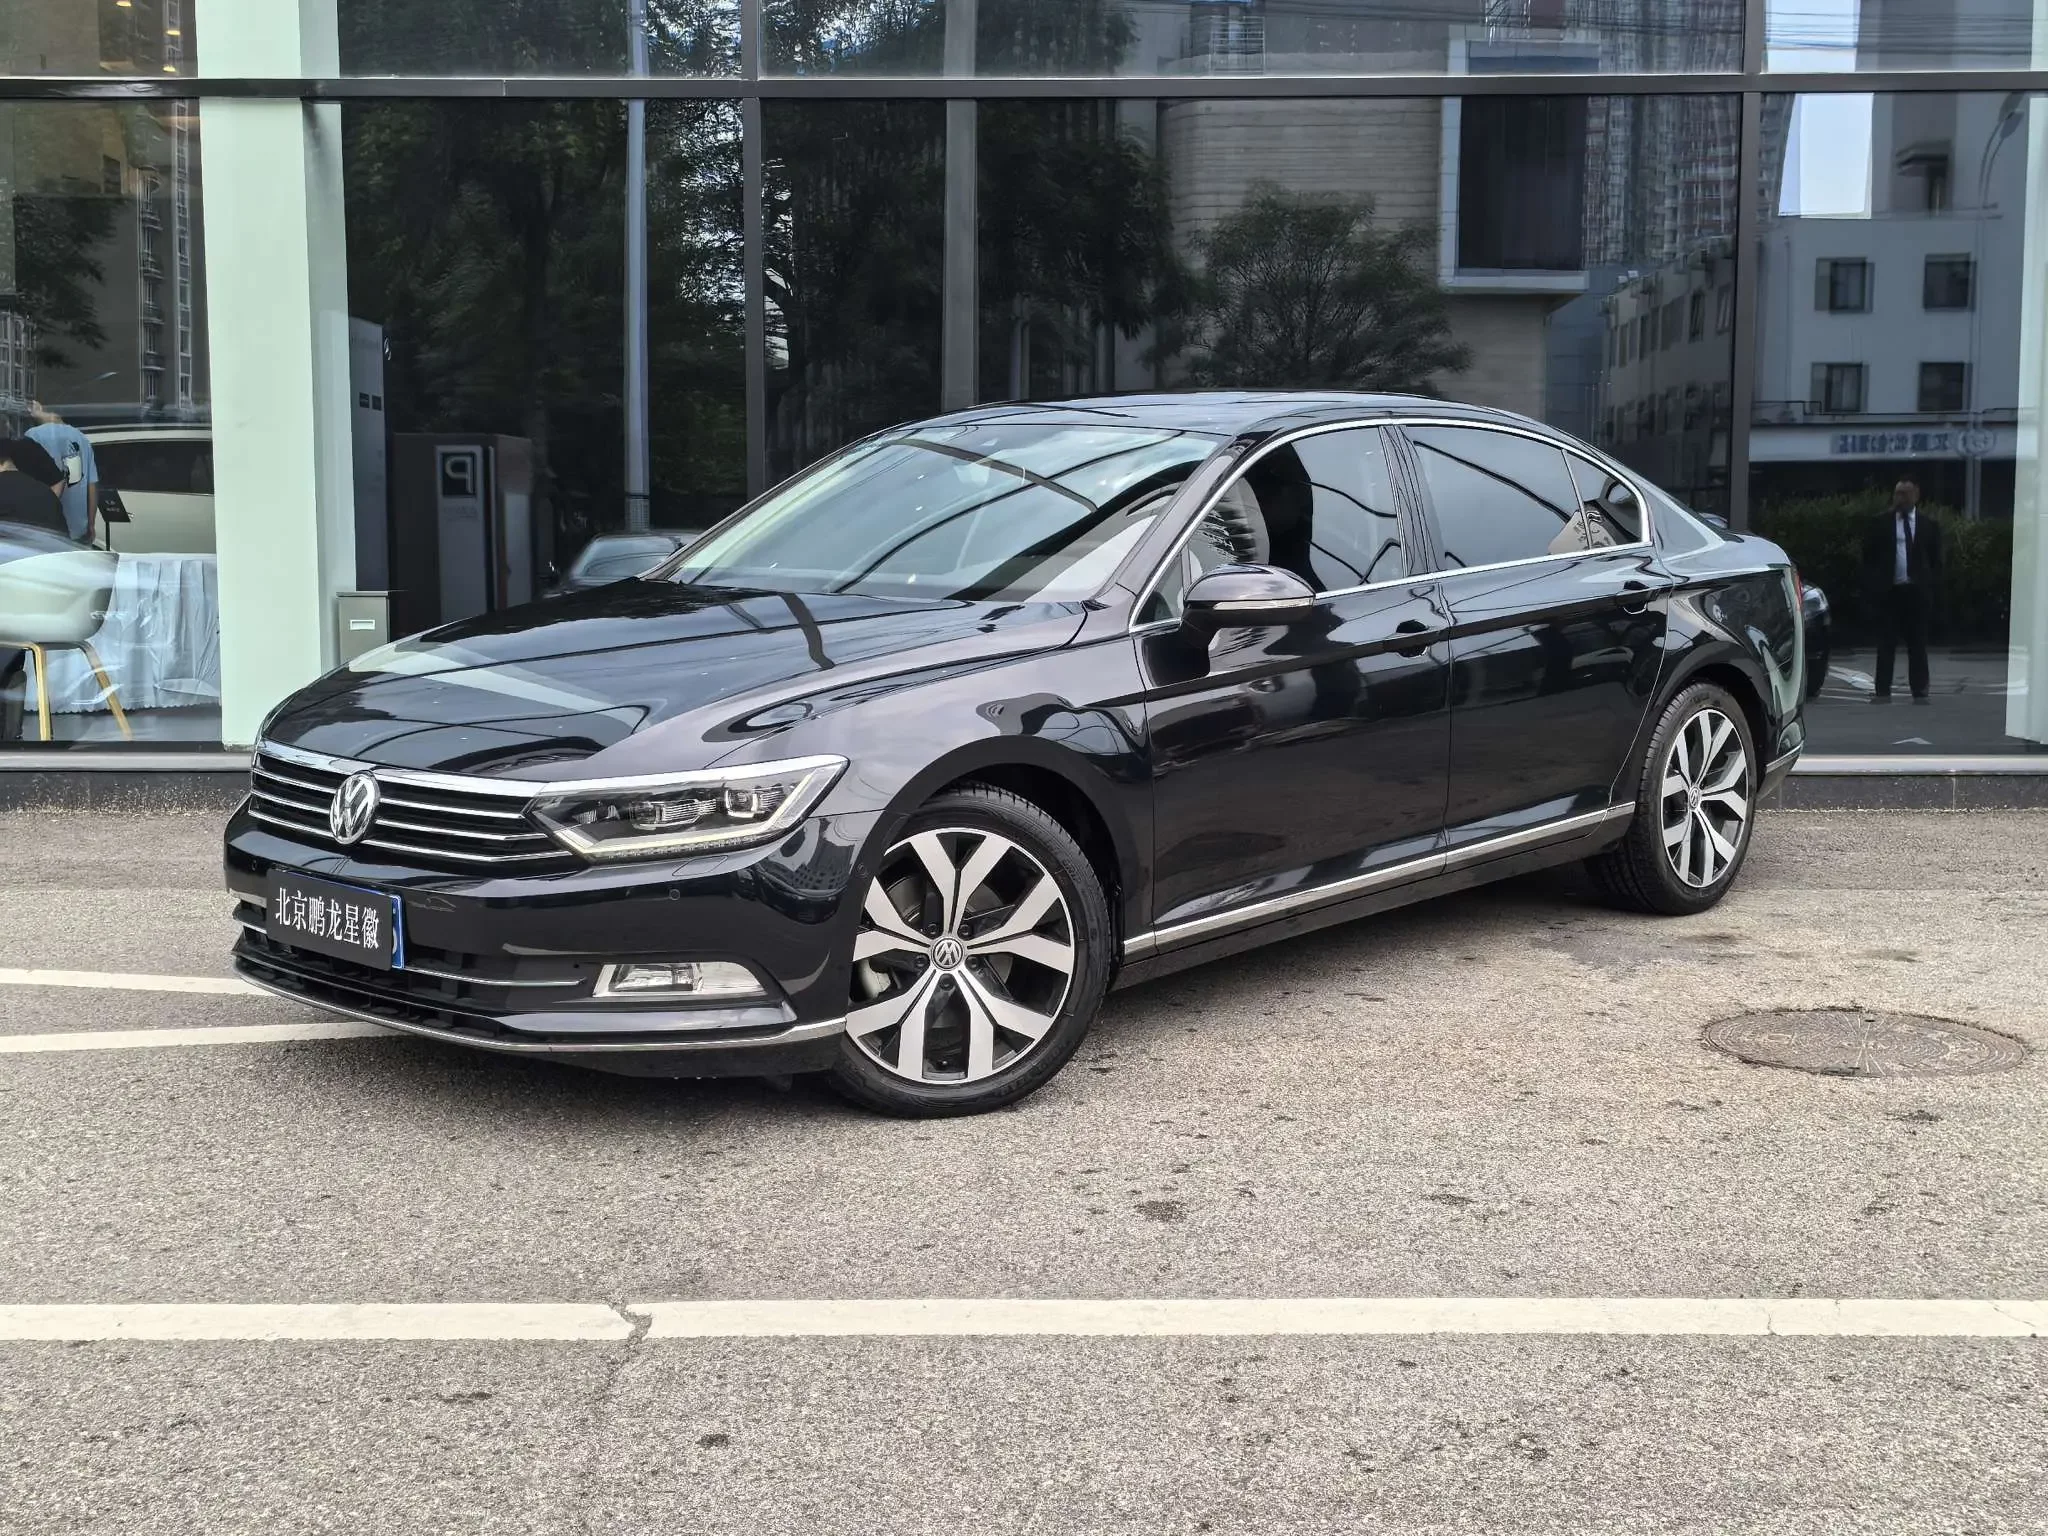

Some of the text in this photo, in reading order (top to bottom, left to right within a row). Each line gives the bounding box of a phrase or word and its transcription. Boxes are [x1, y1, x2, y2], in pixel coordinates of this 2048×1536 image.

[275, 887, 379, 949] 北京鹏龙星徽
